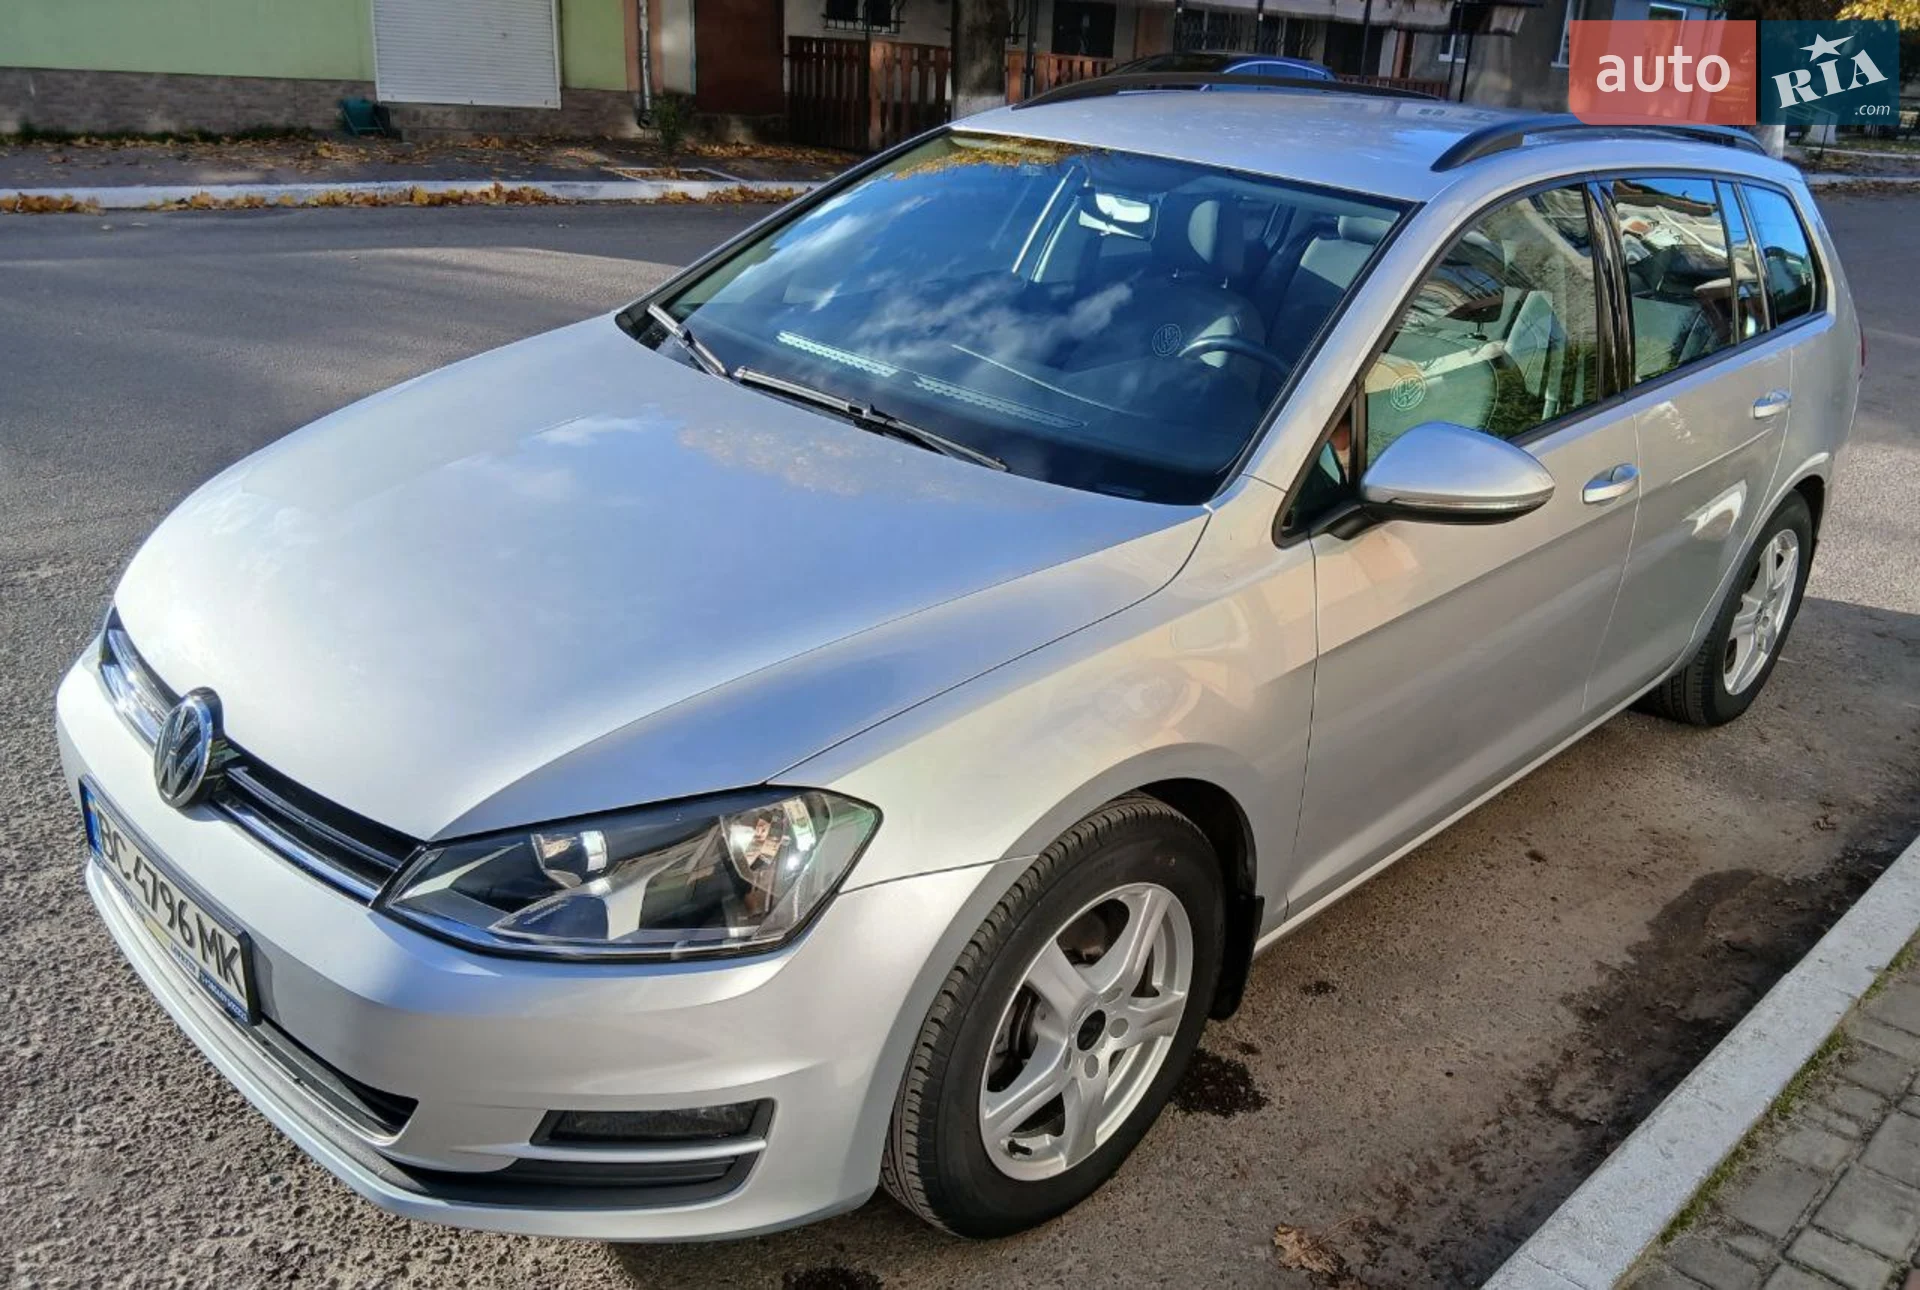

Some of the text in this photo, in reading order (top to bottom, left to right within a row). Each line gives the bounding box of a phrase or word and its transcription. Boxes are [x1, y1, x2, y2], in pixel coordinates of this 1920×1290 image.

[97, 808, 131, 880] BC
[133, 855, 195, 949] 4796
[196, 912, 247, 999] MK
